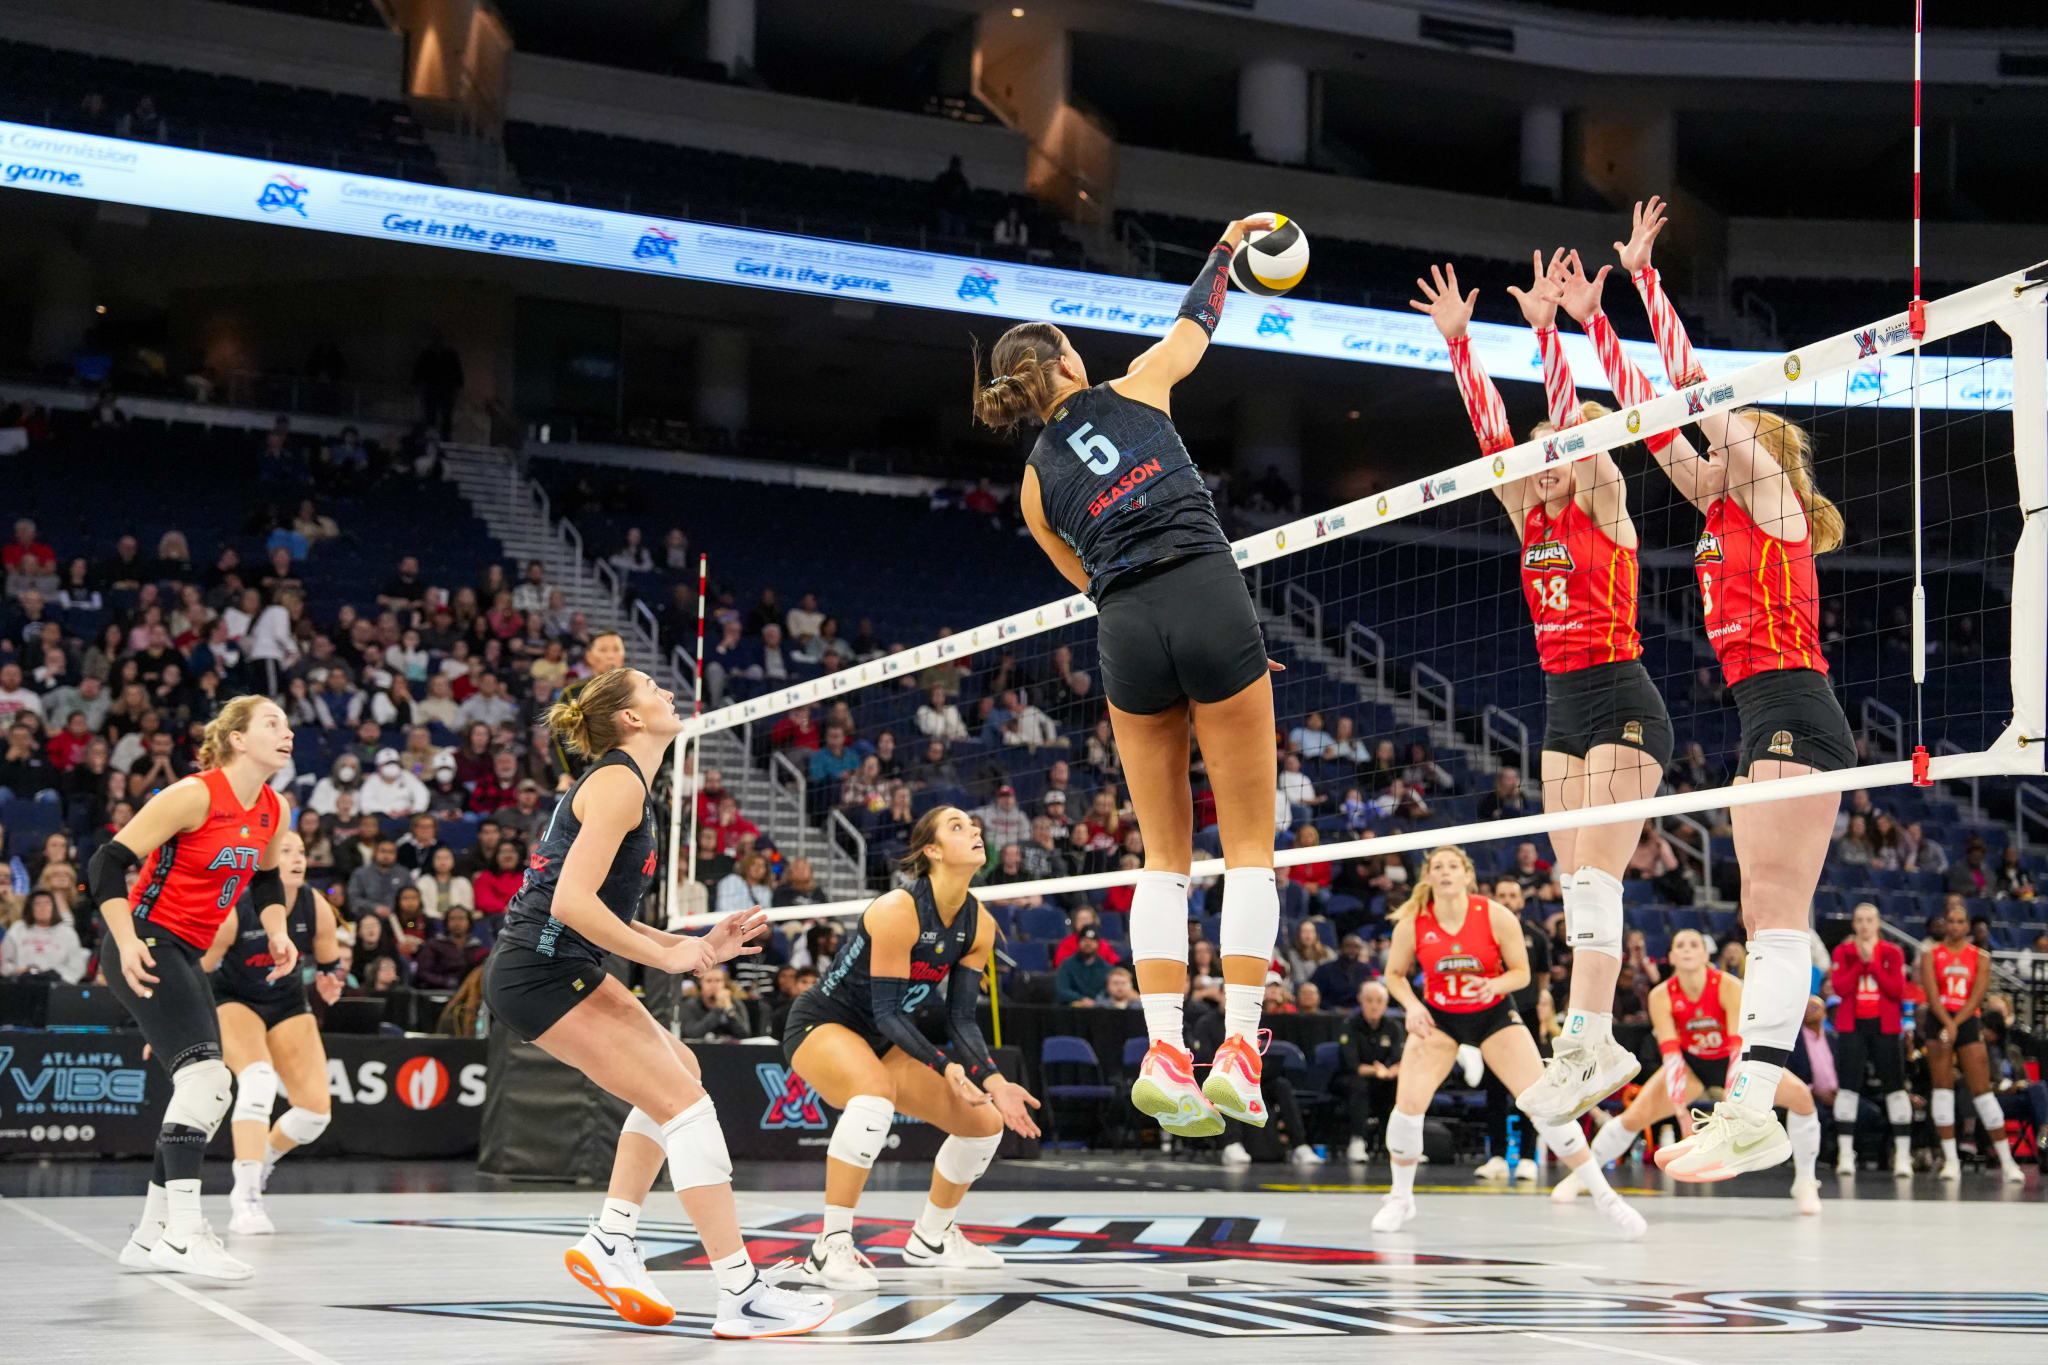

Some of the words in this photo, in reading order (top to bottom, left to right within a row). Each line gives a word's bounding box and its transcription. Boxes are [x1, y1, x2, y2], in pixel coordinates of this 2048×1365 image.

[5, 163, 84, 187] game.
[383, 213, 424, 233] Get
[426, 219, 447, 237] in
[452, 223, 487, 242] the
[489, 231, 558, 251] game.
[735, 257, 771, 277] Get
[774, 261, 793, 280] in
[797, 265, 829, 285] the
[1050, 298, 1081, 315] Get
[1086, 302, 1103, 320] in
[1108, 305, 1137, 323] the
[1342, 333, 1372, 351] Get
[1392, 339, 1421, 357] the
[1704, 385, 1735, 406] VIBE
[1066, 421, 1121, 476] 5
[1558, 436, 1585, 454] VIBE
[1087, 457, 1164, 518] BEASON
[1434, 479, 1457, 496] VIBE
[1525, 545, 1566, 566] FURY
[1531, 575, 1569, 613] 18
[217, 875, 240, 908] 9
[1444, 974, 1480, 998] 12
[1946, 976, 1967, 996] 14
[42, 1052, 124, 1067] ATLANTA
[10, 1067, 146, 1104] VIBE
[16, 1102, 46, 1114] PRO
[51, 1102, 139, 1116] VOLLEYBALL
